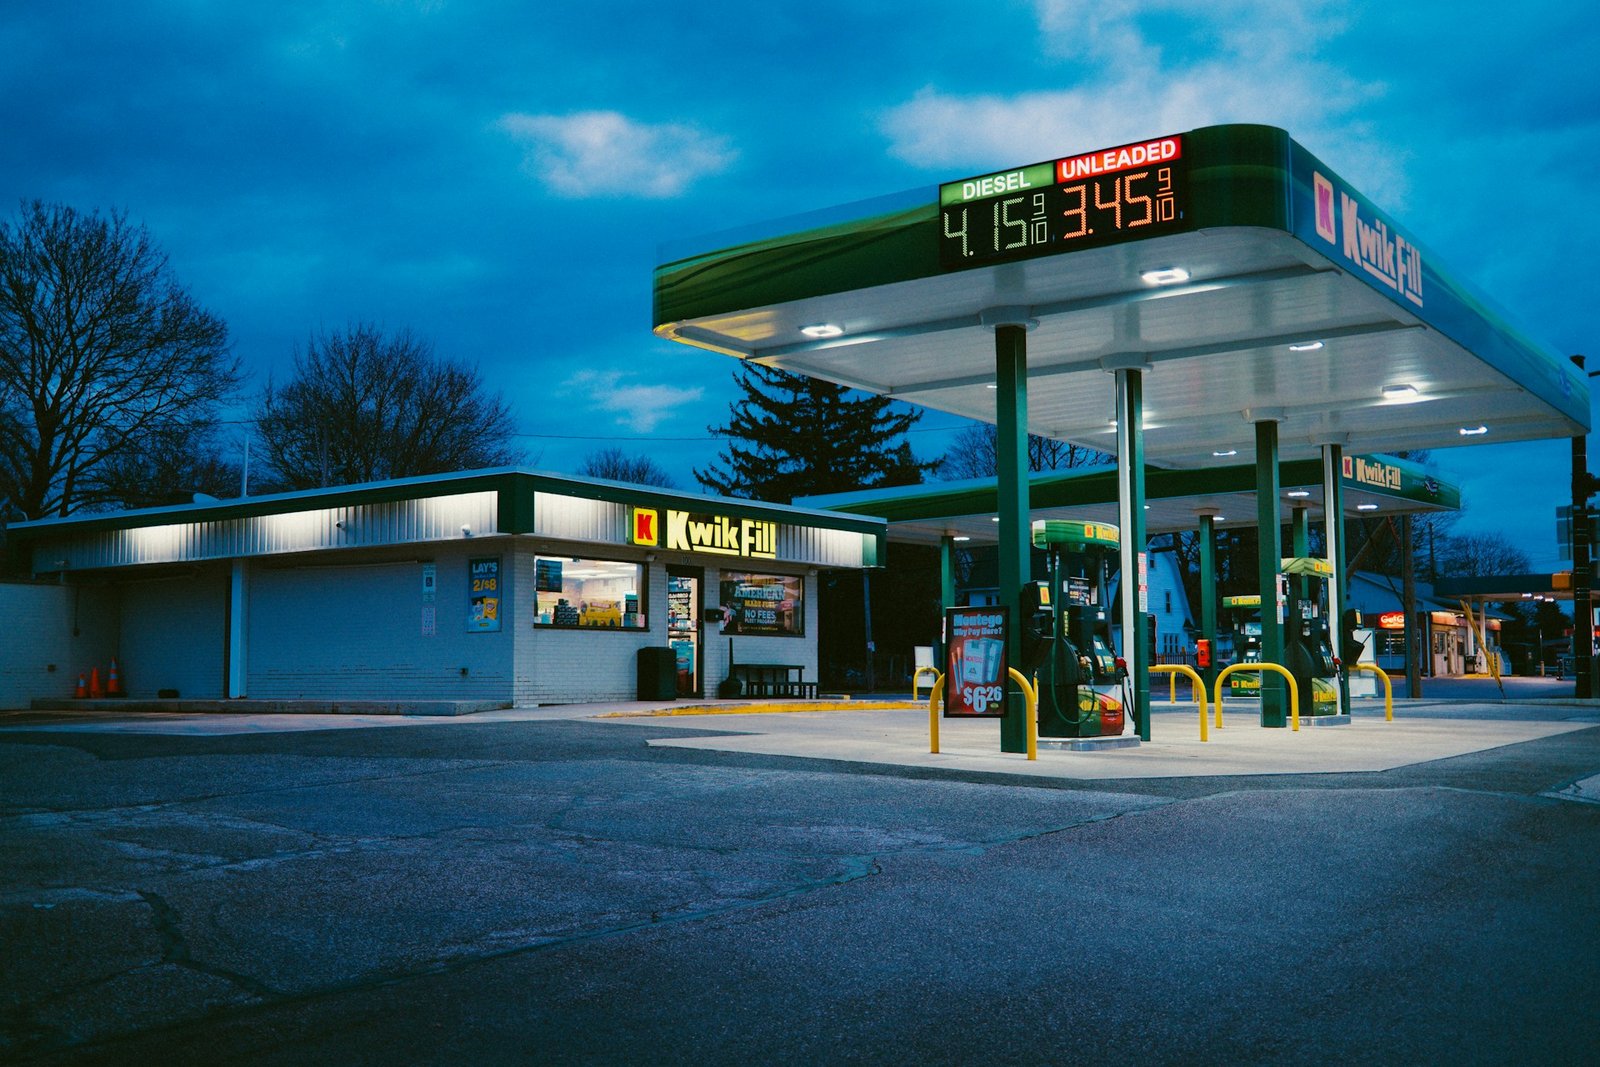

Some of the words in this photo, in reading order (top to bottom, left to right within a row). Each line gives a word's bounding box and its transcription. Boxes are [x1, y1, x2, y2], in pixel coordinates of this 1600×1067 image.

[1062, 140, 1176, 179] UNLEADED
[962, 171, 1031, 200] DIESEL
[1341, 191, 1397, 280] Kwik
[1396, 234, 1422, 298] Fill
[1356, 458, 1386, 483] Kwik
[1386, 465, 1401, 488] Fill
[637, 513, 653, 540] K
[666, 509, 740, 551] Kwik
[741, 518, 776, 557] Fill
[472, 562, 498, 573] LAY'S
[473, 578, 497, 592] 2/$8
[734, 584, 785, 600] AMERICAN
[745, 609, 756, 618] NO
[757, 610, 776, 619] FEES
[953, 614, 1003, 628] Montego
[1380, 615, 1404, 624] GetG
